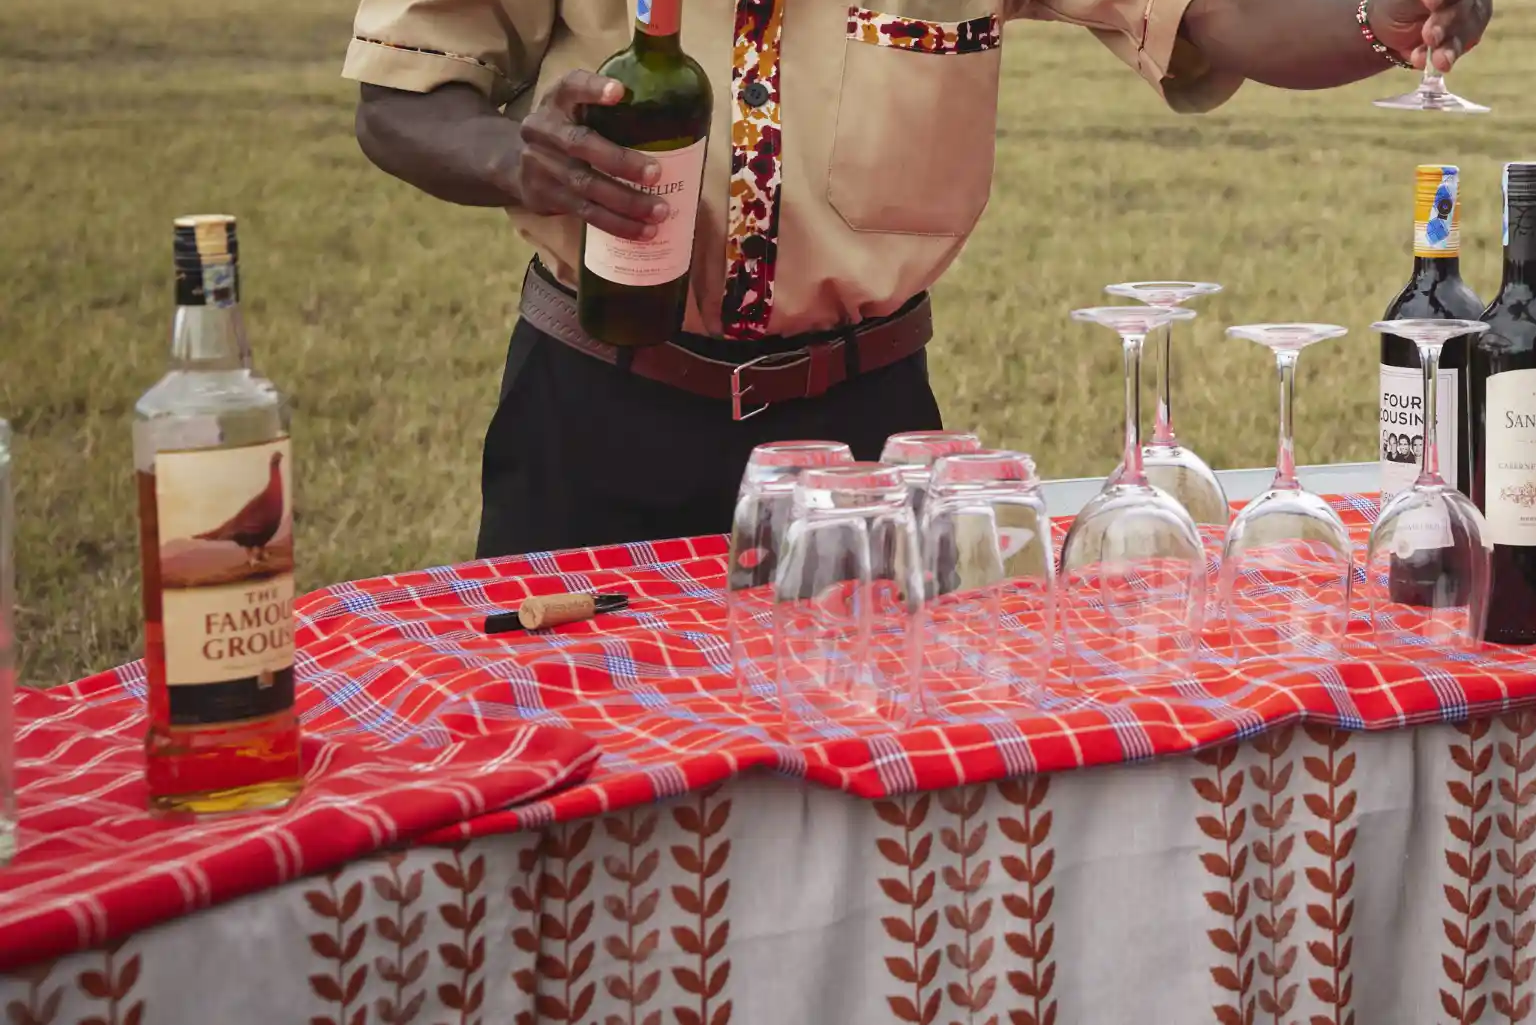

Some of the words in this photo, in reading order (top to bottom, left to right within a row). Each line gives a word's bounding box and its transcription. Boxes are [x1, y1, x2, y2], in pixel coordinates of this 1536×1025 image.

[1384, 392, 1423, 409] FOUR
[1380, 407, 1439, 426] OUSIN
[1505, 410, 1536, 429] SAN
[245, 589, 279, 604] THE
[205, 600, 294, 636] FAMOU
